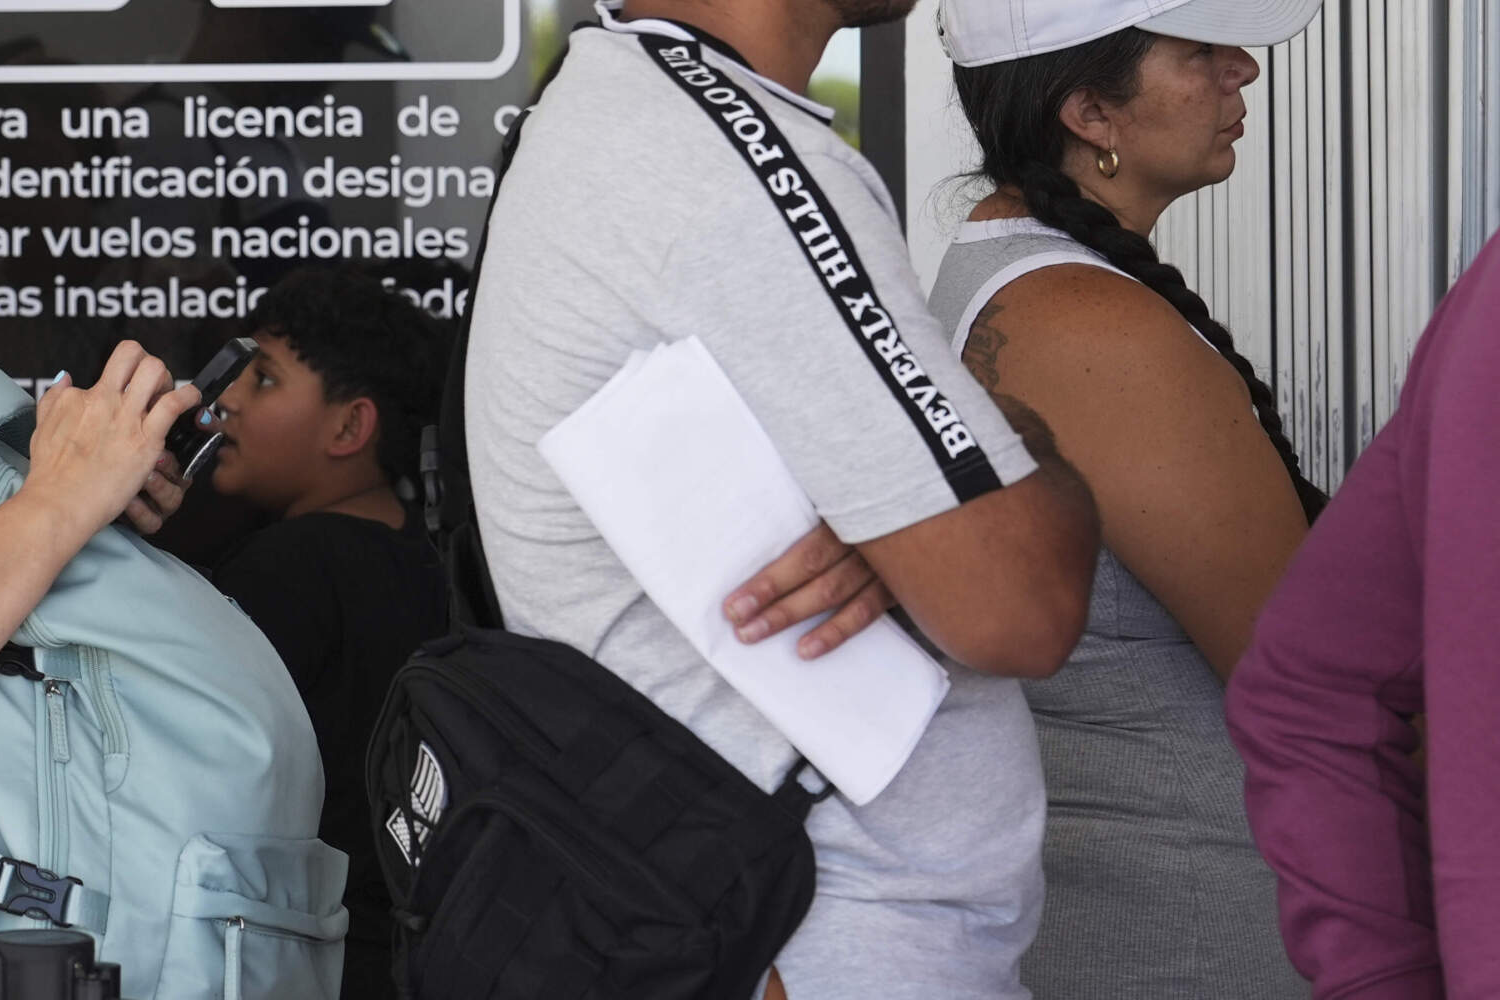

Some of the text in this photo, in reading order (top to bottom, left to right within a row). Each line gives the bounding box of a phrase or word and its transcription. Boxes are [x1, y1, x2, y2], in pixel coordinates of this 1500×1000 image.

[61, 106, 150, 139] una
[184, 94, 364, 138] licencia
[397, 94, 460, 137] de
[702, 87, 784, 167] POLO
[302, 154, 495, 207] designa
[41, 216, 198, 258] vuelos
[211, 214, 470, 259] nacionales
[766, 167, 858, 290] HILLS
[841, 292, 977, 460] BEVERLY
